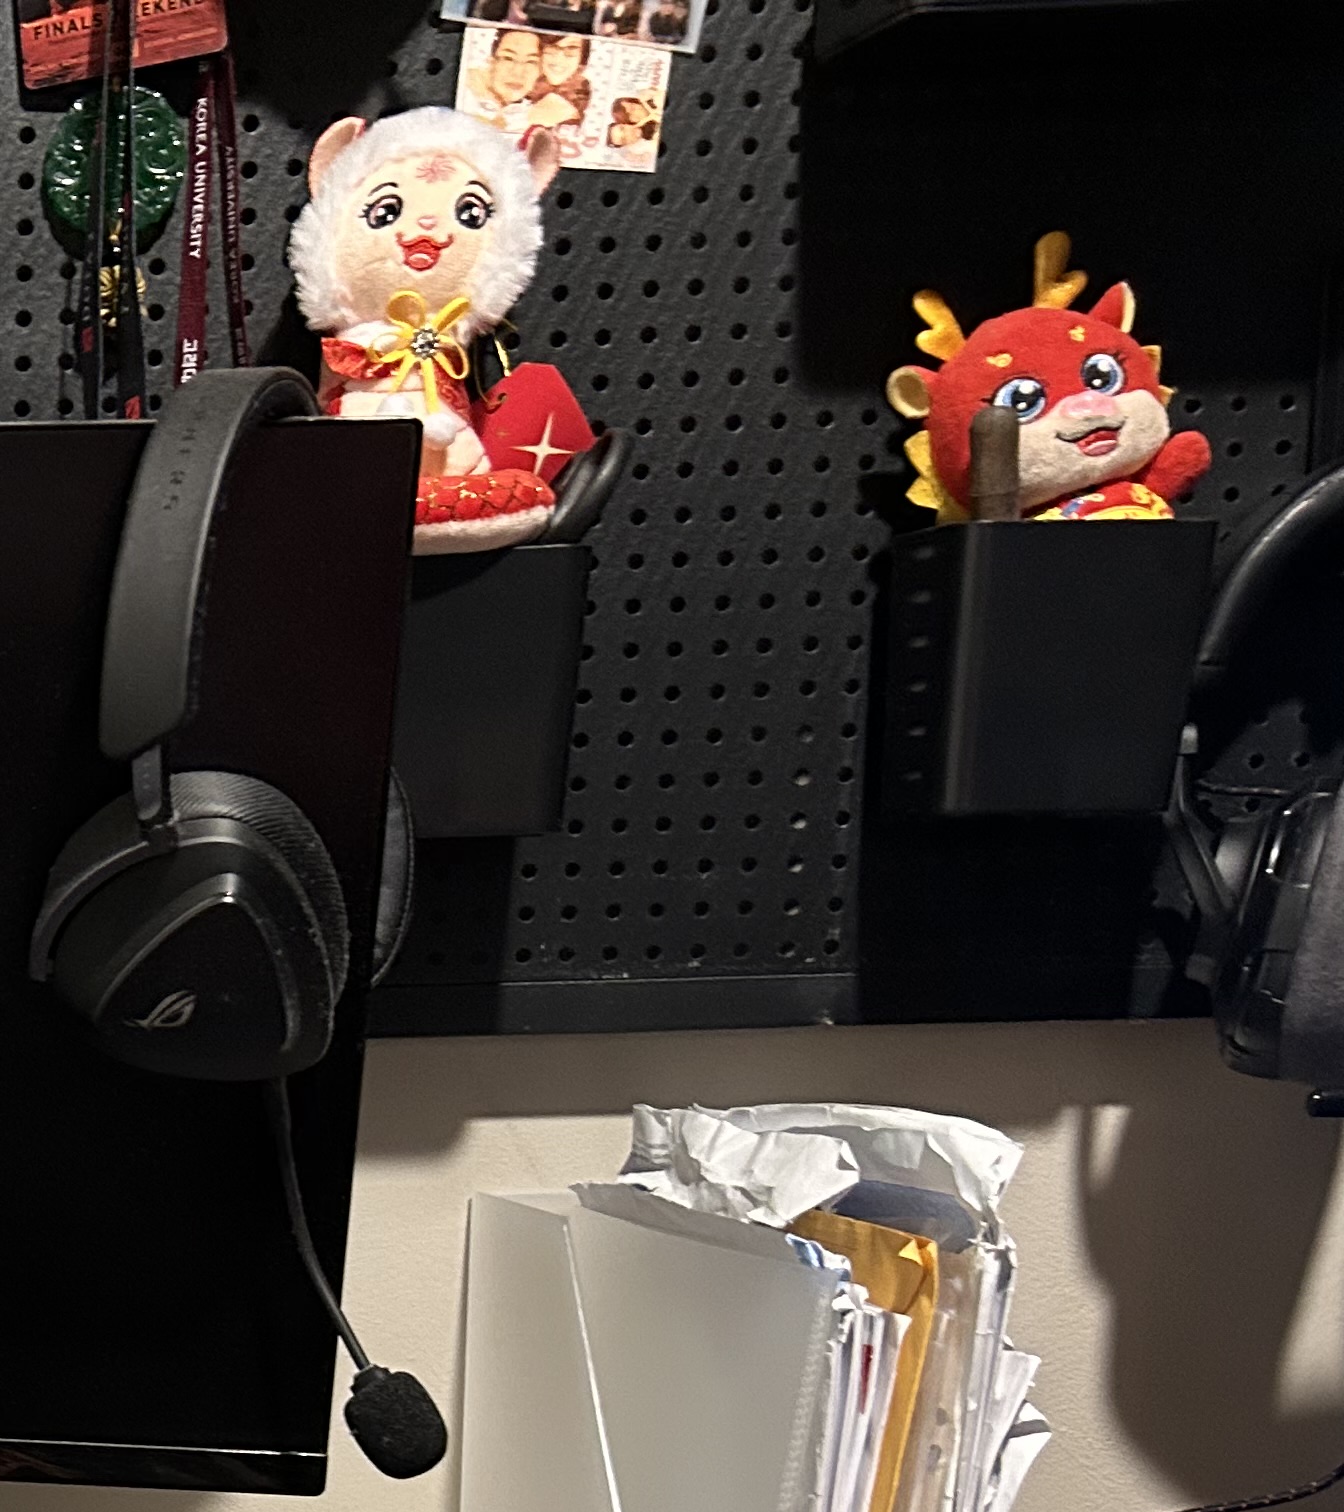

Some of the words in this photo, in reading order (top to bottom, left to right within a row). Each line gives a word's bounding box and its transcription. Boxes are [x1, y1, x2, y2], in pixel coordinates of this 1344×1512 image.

[33, 13, 103, 41] FINALS
[195, 97, 208, 155] KOREA
[189, 161, 208, 259] UNIVERSITY
